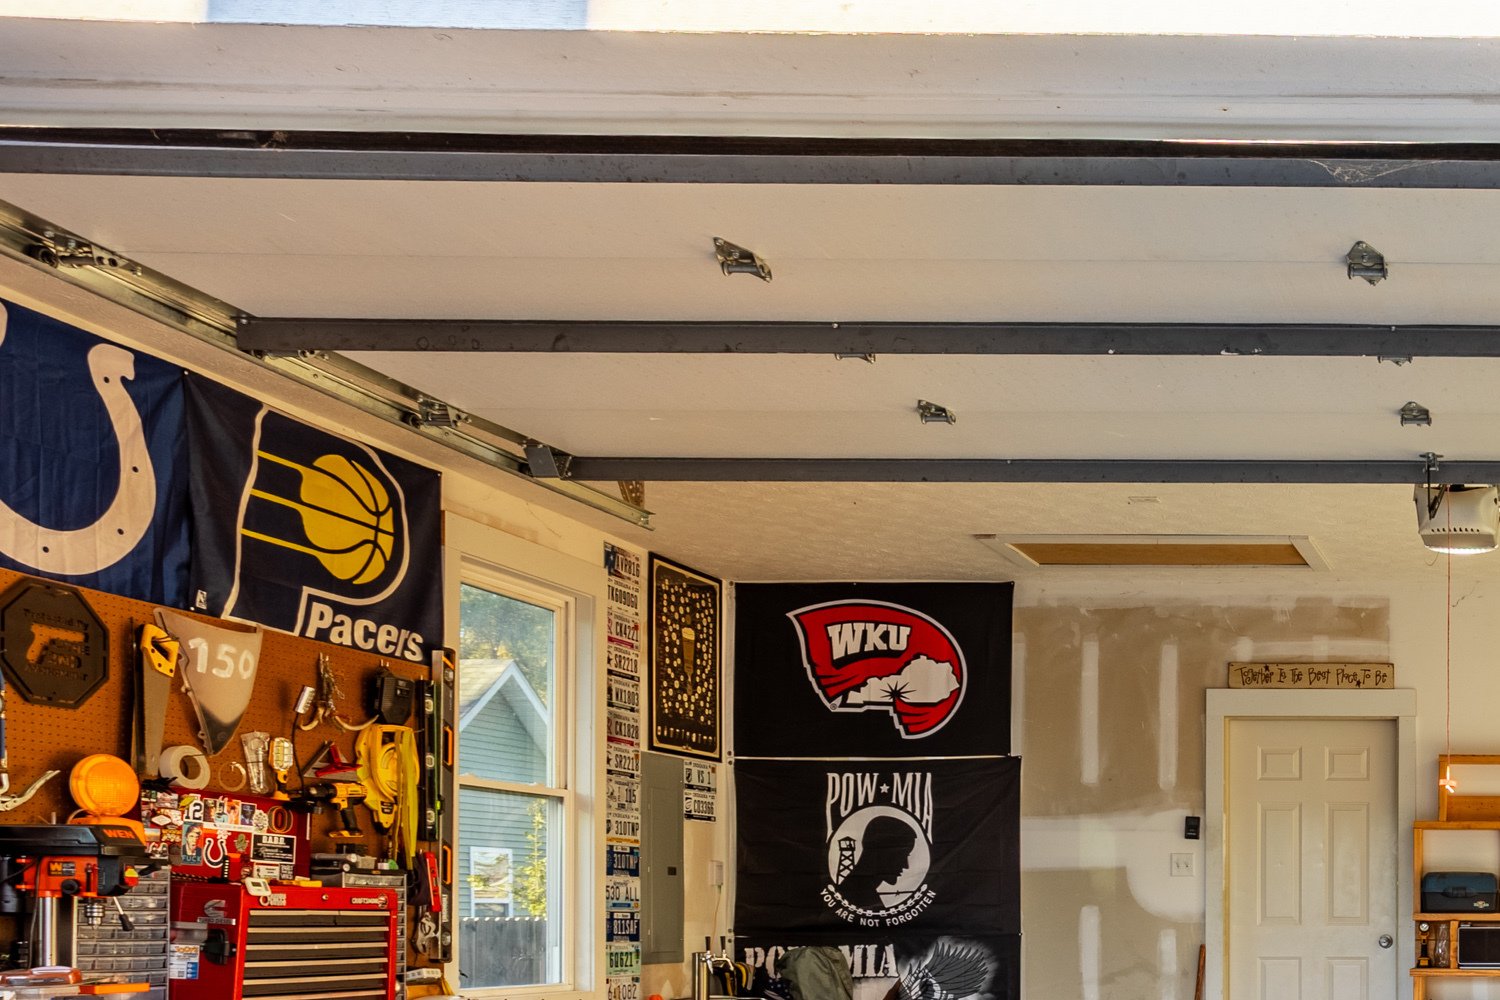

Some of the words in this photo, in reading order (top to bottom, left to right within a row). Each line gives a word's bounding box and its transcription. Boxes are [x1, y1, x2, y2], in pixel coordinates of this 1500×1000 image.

[305, 601, 423, 662] Pacers
[827, 622, 911, 661] WKU
[188, 637, 255, 680] 150
[1234, 667, 1274, 686] Together
[1277, 668, 1287, 683] Is
[1290, 668, 1303, 685] The
[1308, 667, 1331, 686] Best
[1336, 667, 1358, 686] Place
[1360, 669, 1371, 685] To
[1375, 670, 1388, 686] Be
[826, 772, 880, 843] POW
[891, 772, 933, 844] MIA
[103, 829, 135, 839] WEN
[625, 886, 640, 902] ALL
[820, 888, 836, 907] YOU
[835, 908, 855, 922] ARE
[860, 917, 880, 927] NOT
[886, 890, 937, 926] FORGOTTEN
